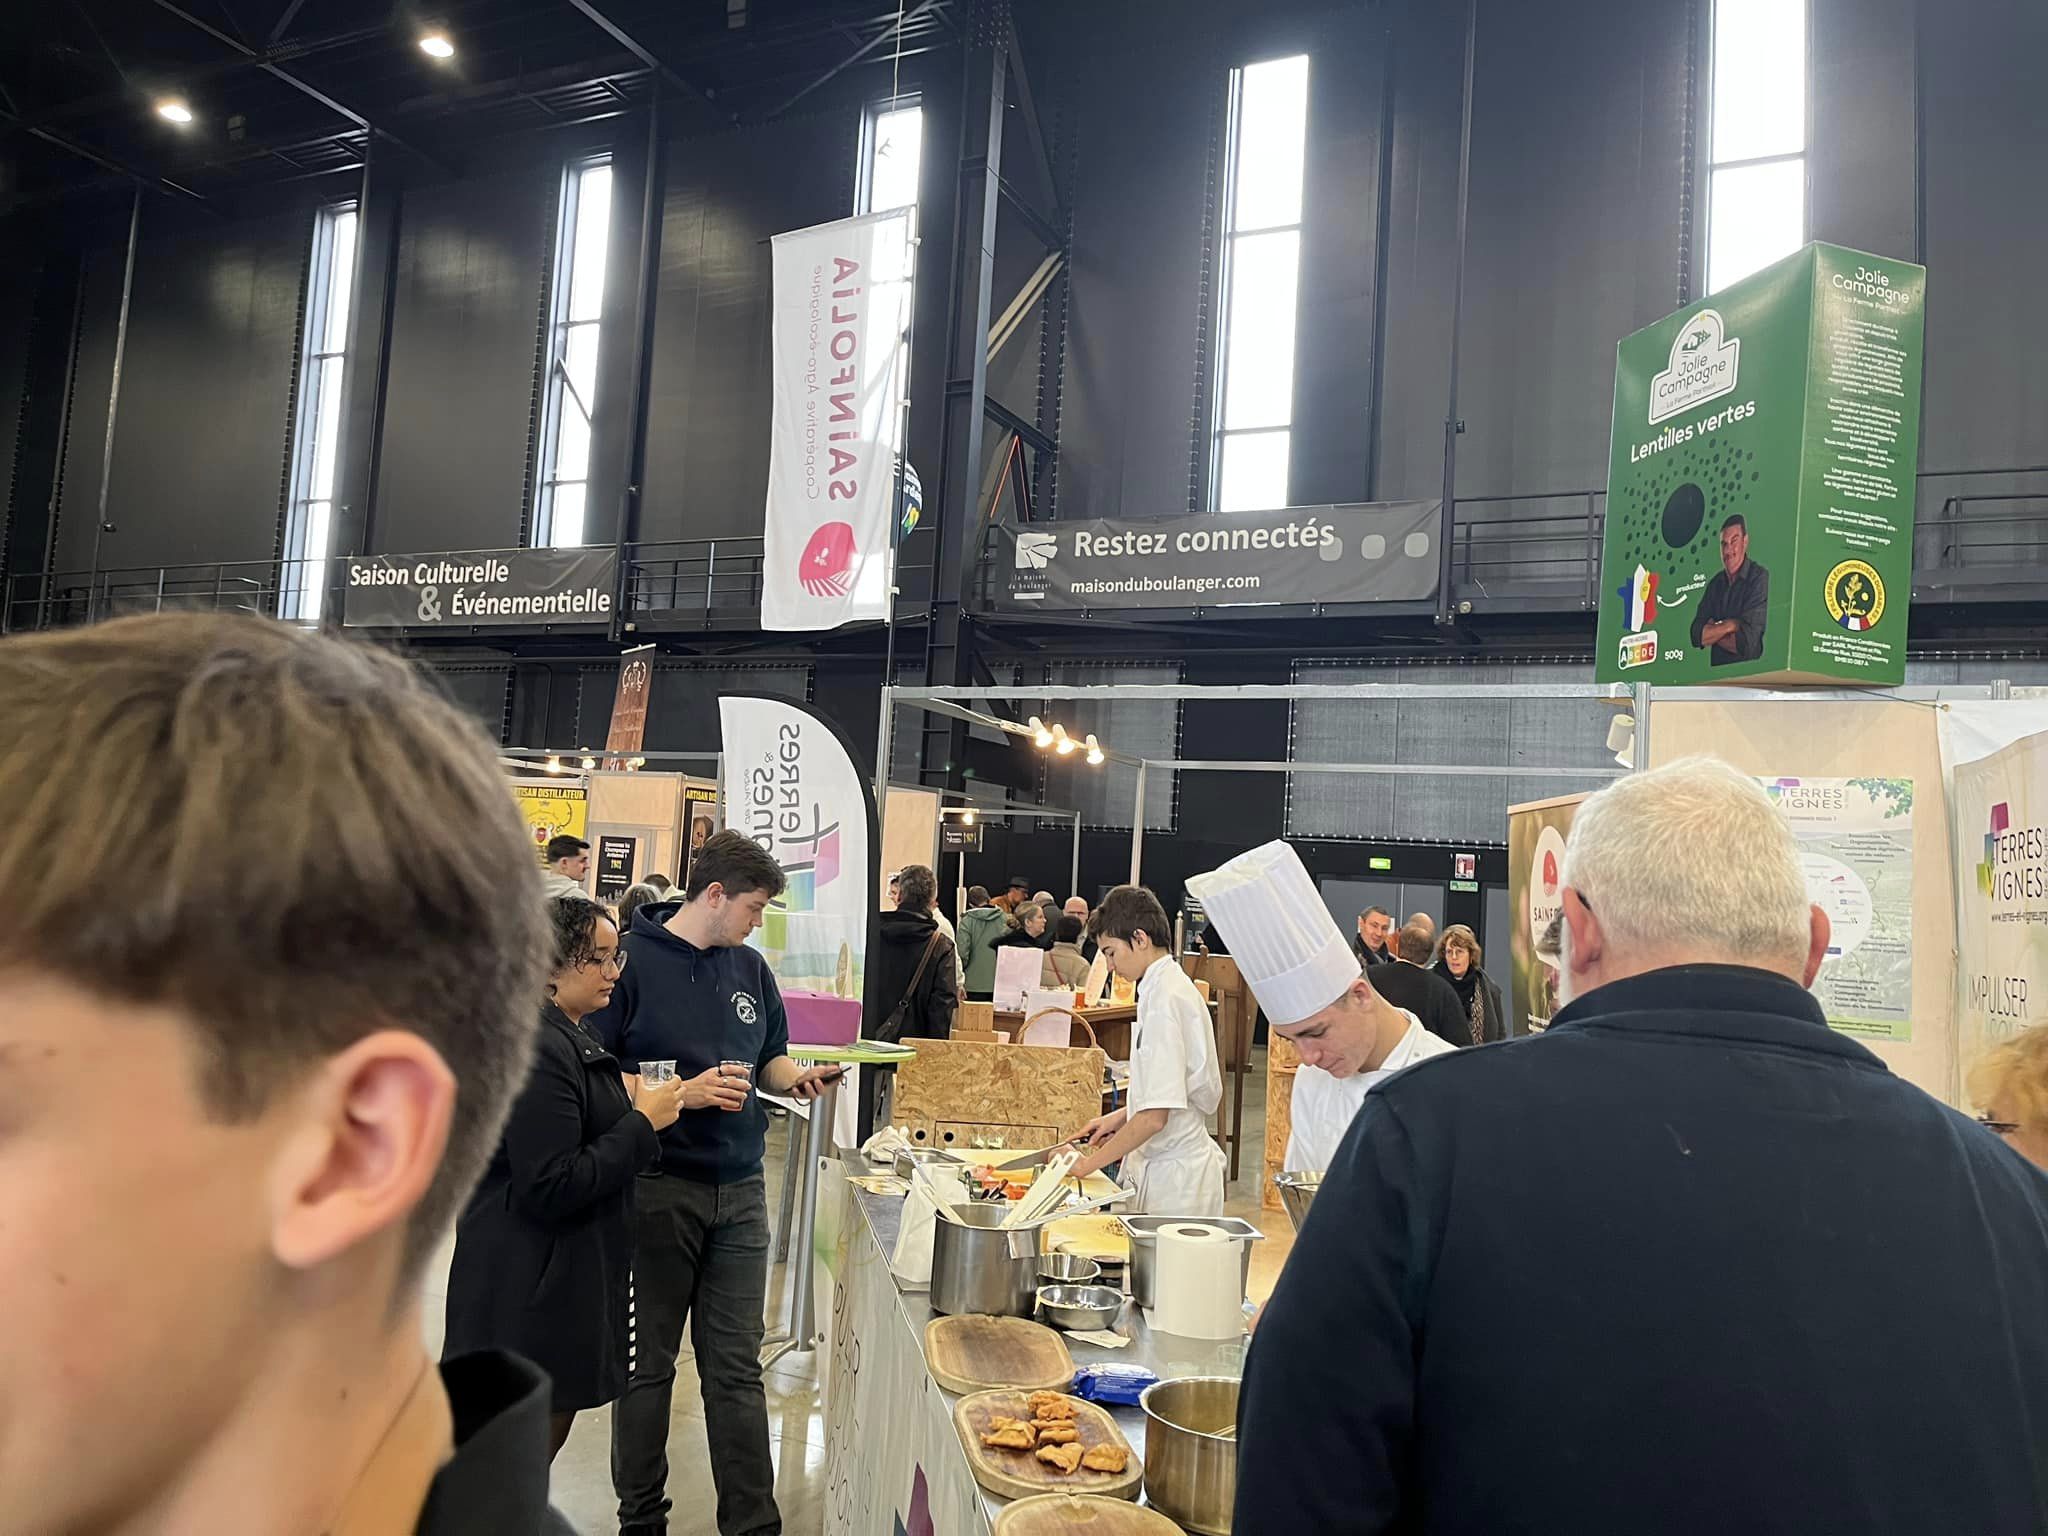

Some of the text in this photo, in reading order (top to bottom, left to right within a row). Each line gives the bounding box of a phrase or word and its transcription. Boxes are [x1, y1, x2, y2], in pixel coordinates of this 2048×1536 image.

[1833, 274, 1909, 304] Campagne
[1855, 266, 1889, 286] Jolie
[1659, 360, 1727, 398] Campagne
[1678, 355, 1708, 376] Jolie
[1631, 400, 1755, 463] Lentilles vertes
[1074, 517, 1335, 558] Restez connectés
[350, 559, 509, 586] Saison Culturelle
[1071, 575, 1260, 594] maisonduboulanger.com
[417, 585, 610, 621] & Événementielle
[1665, 648, 1684, 661] 500g
[538, 788, 584, 799] DISTILLATEUR
[685, 789, 708, 800] ARTISAN
[1783, 788, 1843, 798] TERRES
[1994, 828, 2042, 866] TERRES
[1989, 867, 2043, 902] VIGNES
[1969, 976, 2028, 1019] IMPULSER
